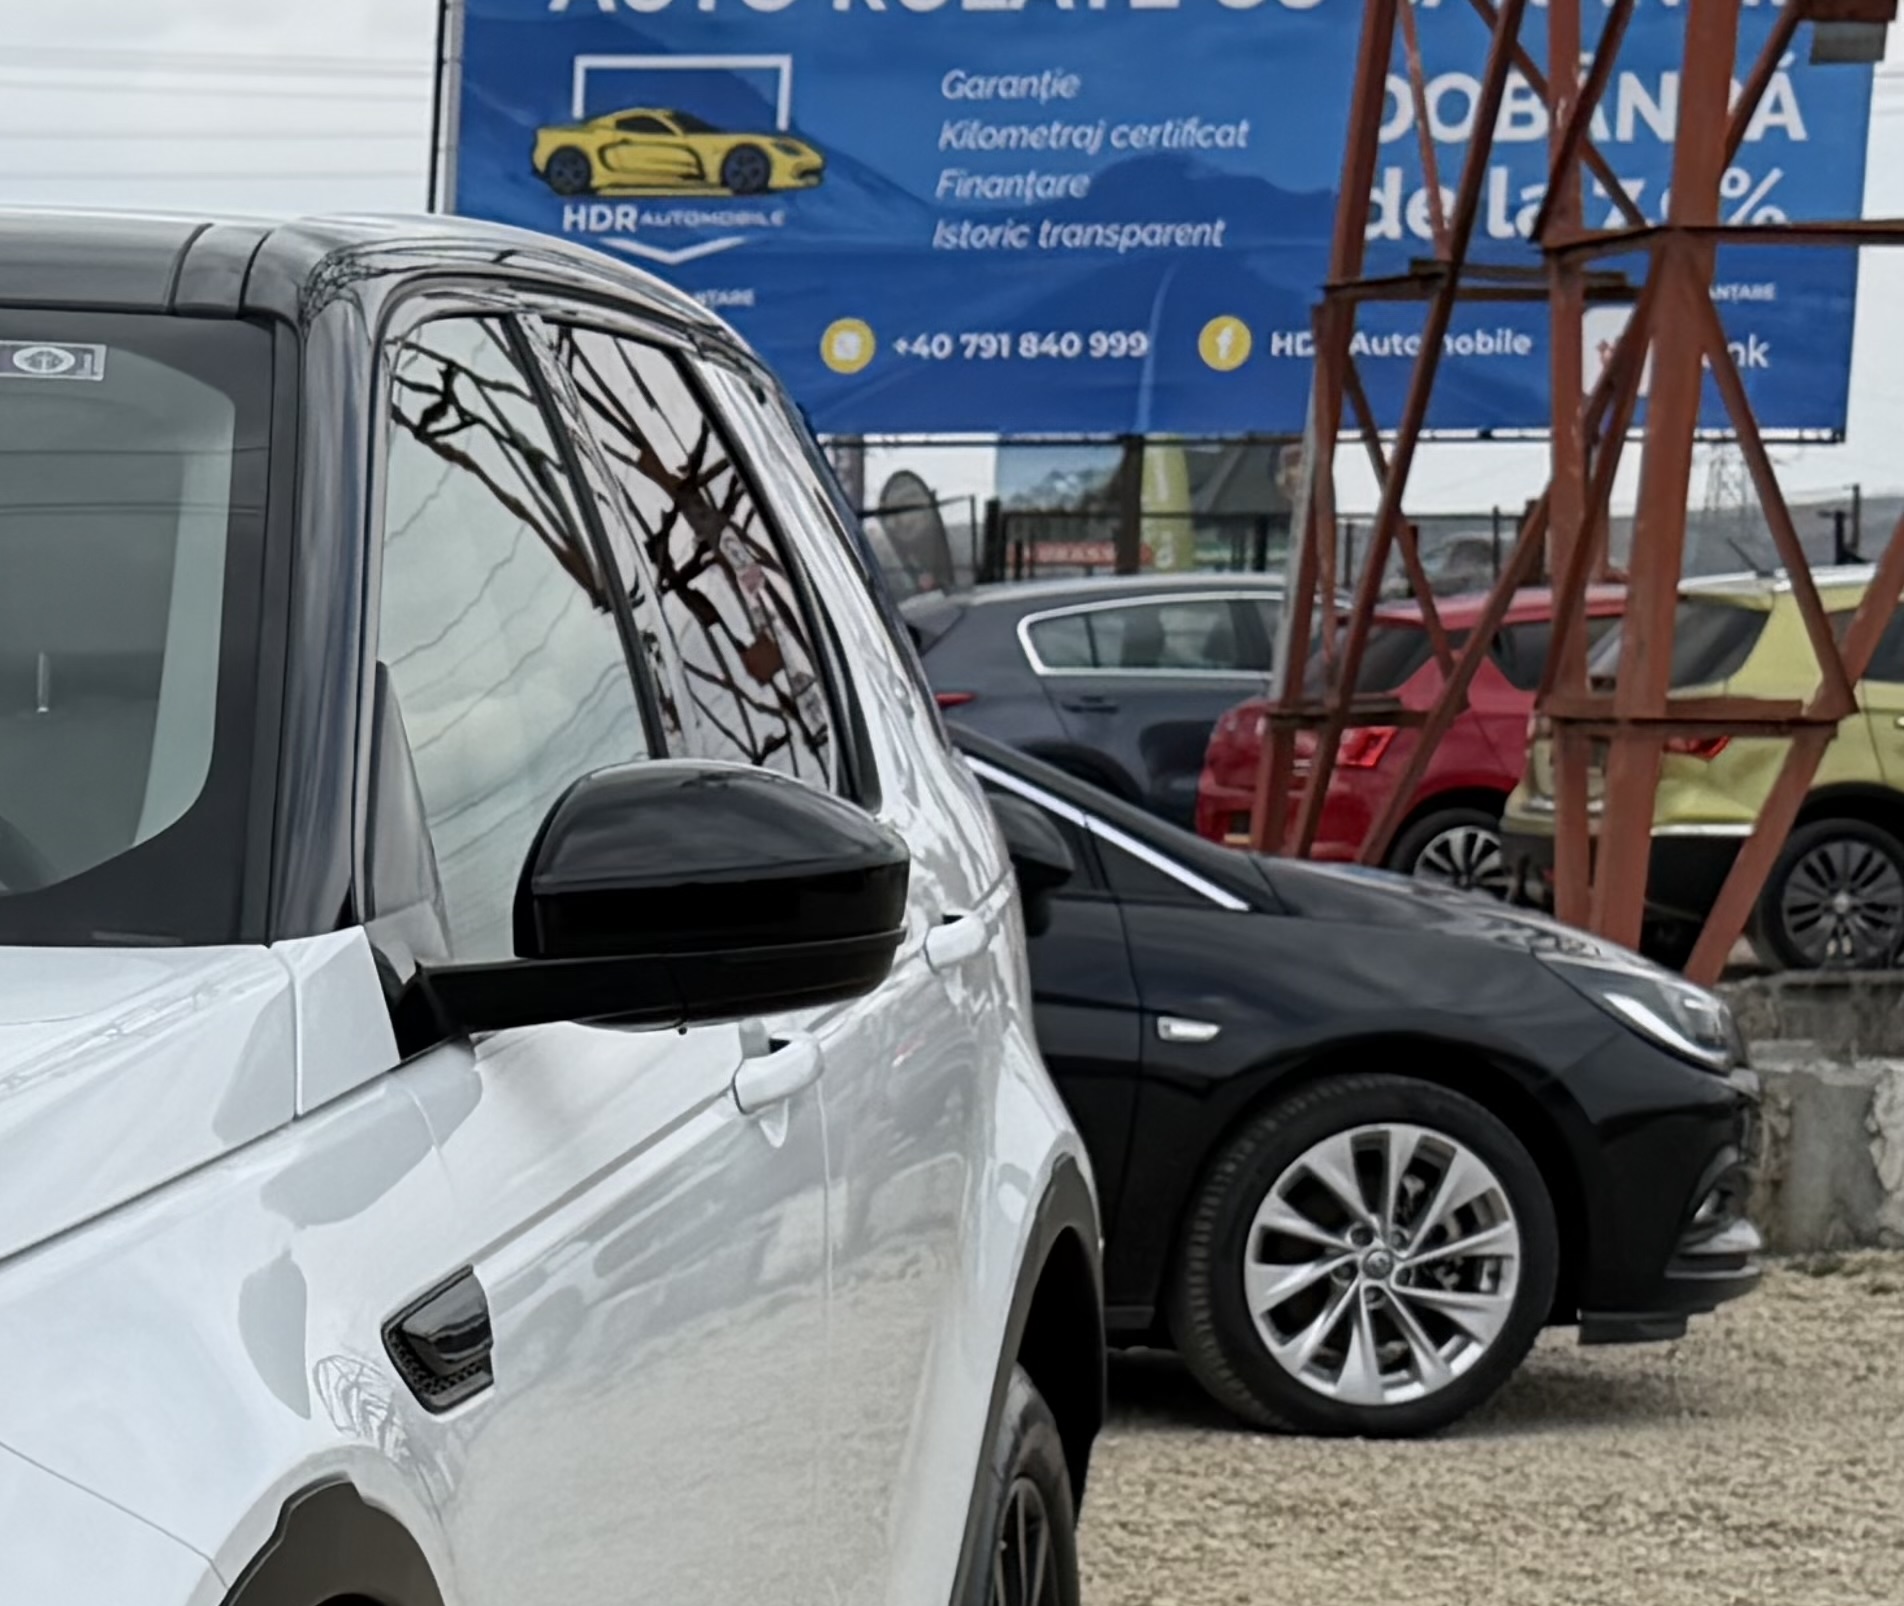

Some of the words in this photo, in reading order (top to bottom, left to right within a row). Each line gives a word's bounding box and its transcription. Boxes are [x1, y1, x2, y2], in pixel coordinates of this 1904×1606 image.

[938, 118, 1104, 155] Kilometraj
[1110, 116, 1250, 149] certificat
[563, 204, 638, 232] HDR
[639, 208, 785, 229] AUTOMOBILE
[932, 219, 1031, 250] Istoric
[1038, 219, 1226, 254] transparent
[894, 333, 953, 360] +40
[959, 333, 1011, 359] 791
[1018, 331, 1083, 358] 840
[1089, 330, 1151, 358] 999
[1270, 331, 1316, 358] HD
